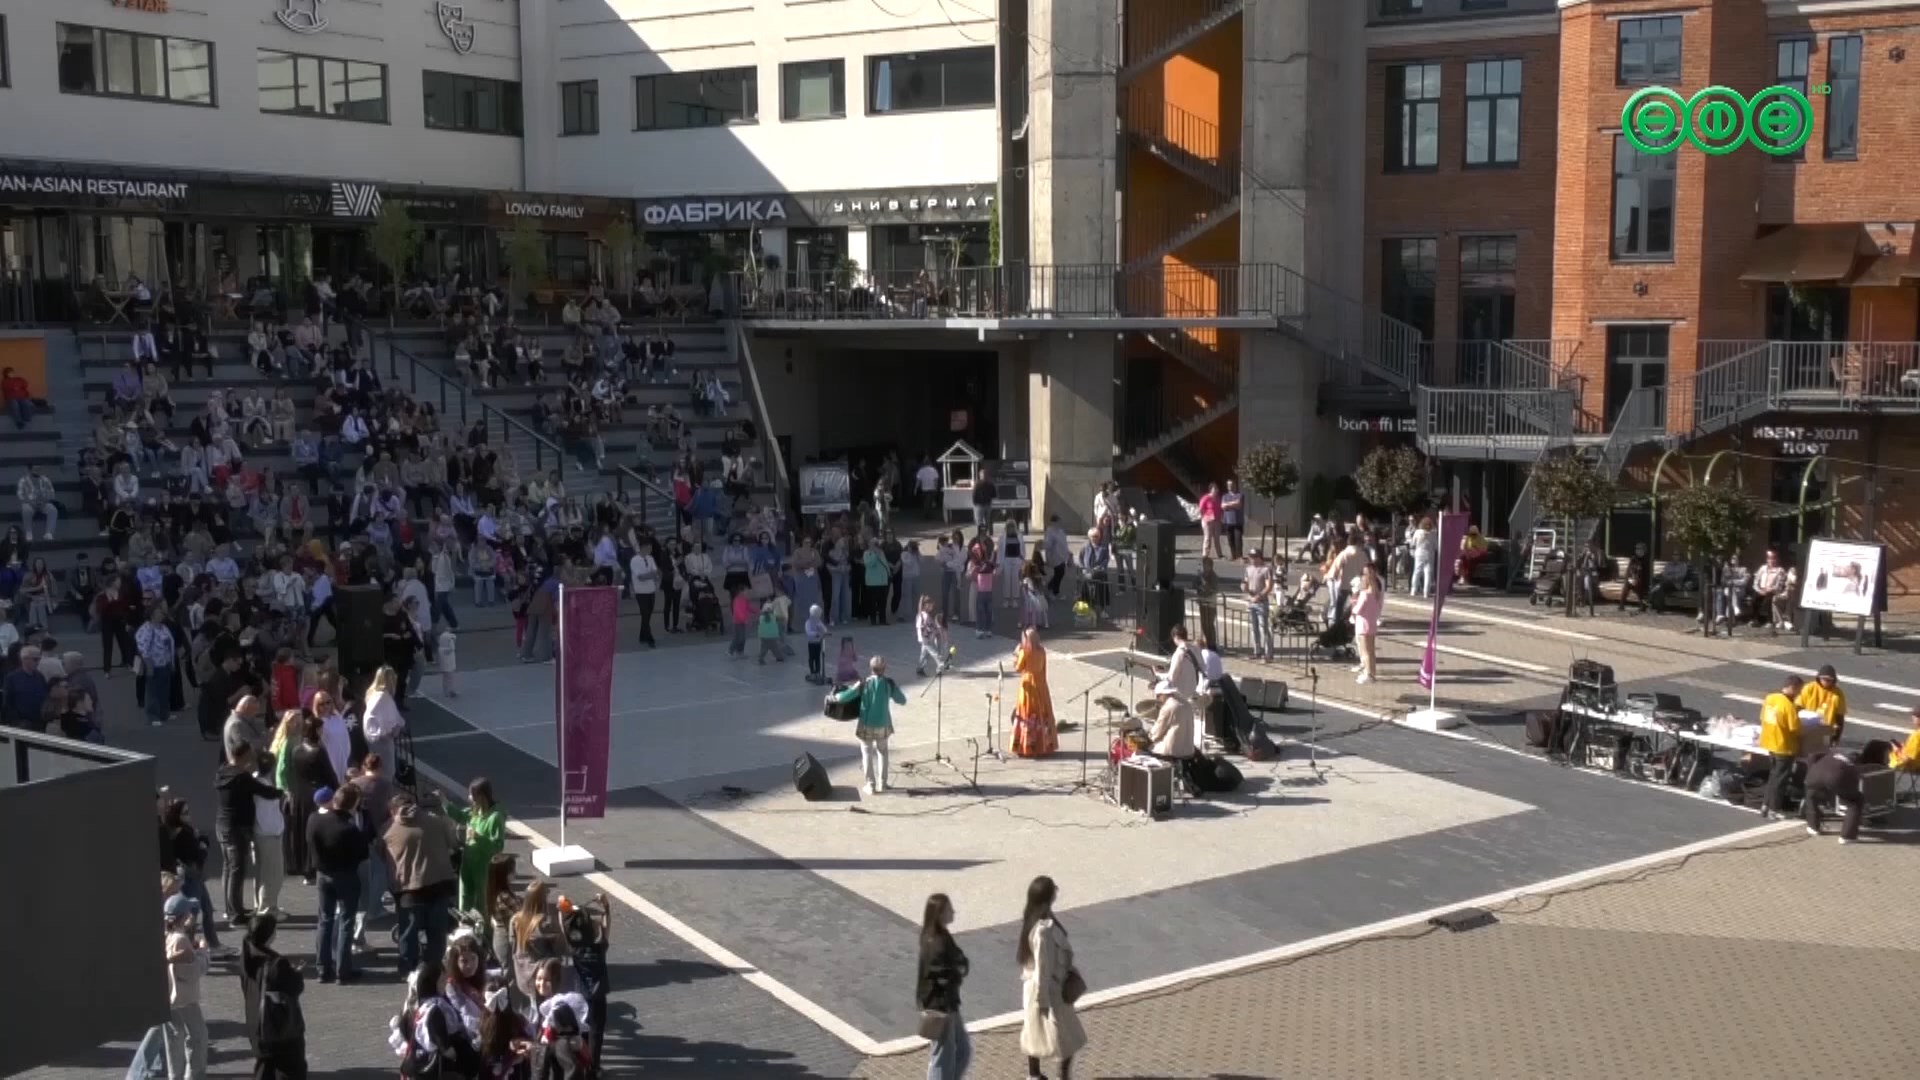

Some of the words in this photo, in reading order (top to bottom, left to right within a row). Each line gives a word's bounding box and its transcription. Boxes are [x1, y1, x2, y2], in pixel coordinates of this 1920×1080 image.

[87, 179, 188, 198] RESTAURANT
[505, 203, 548, 216] LOVKOV
[550, 205, 585, 218] FAMILY
[643, 200, 787, 225] ФАБРИКА
[834, 197, 994, 212] УНИВЕРМАГ
